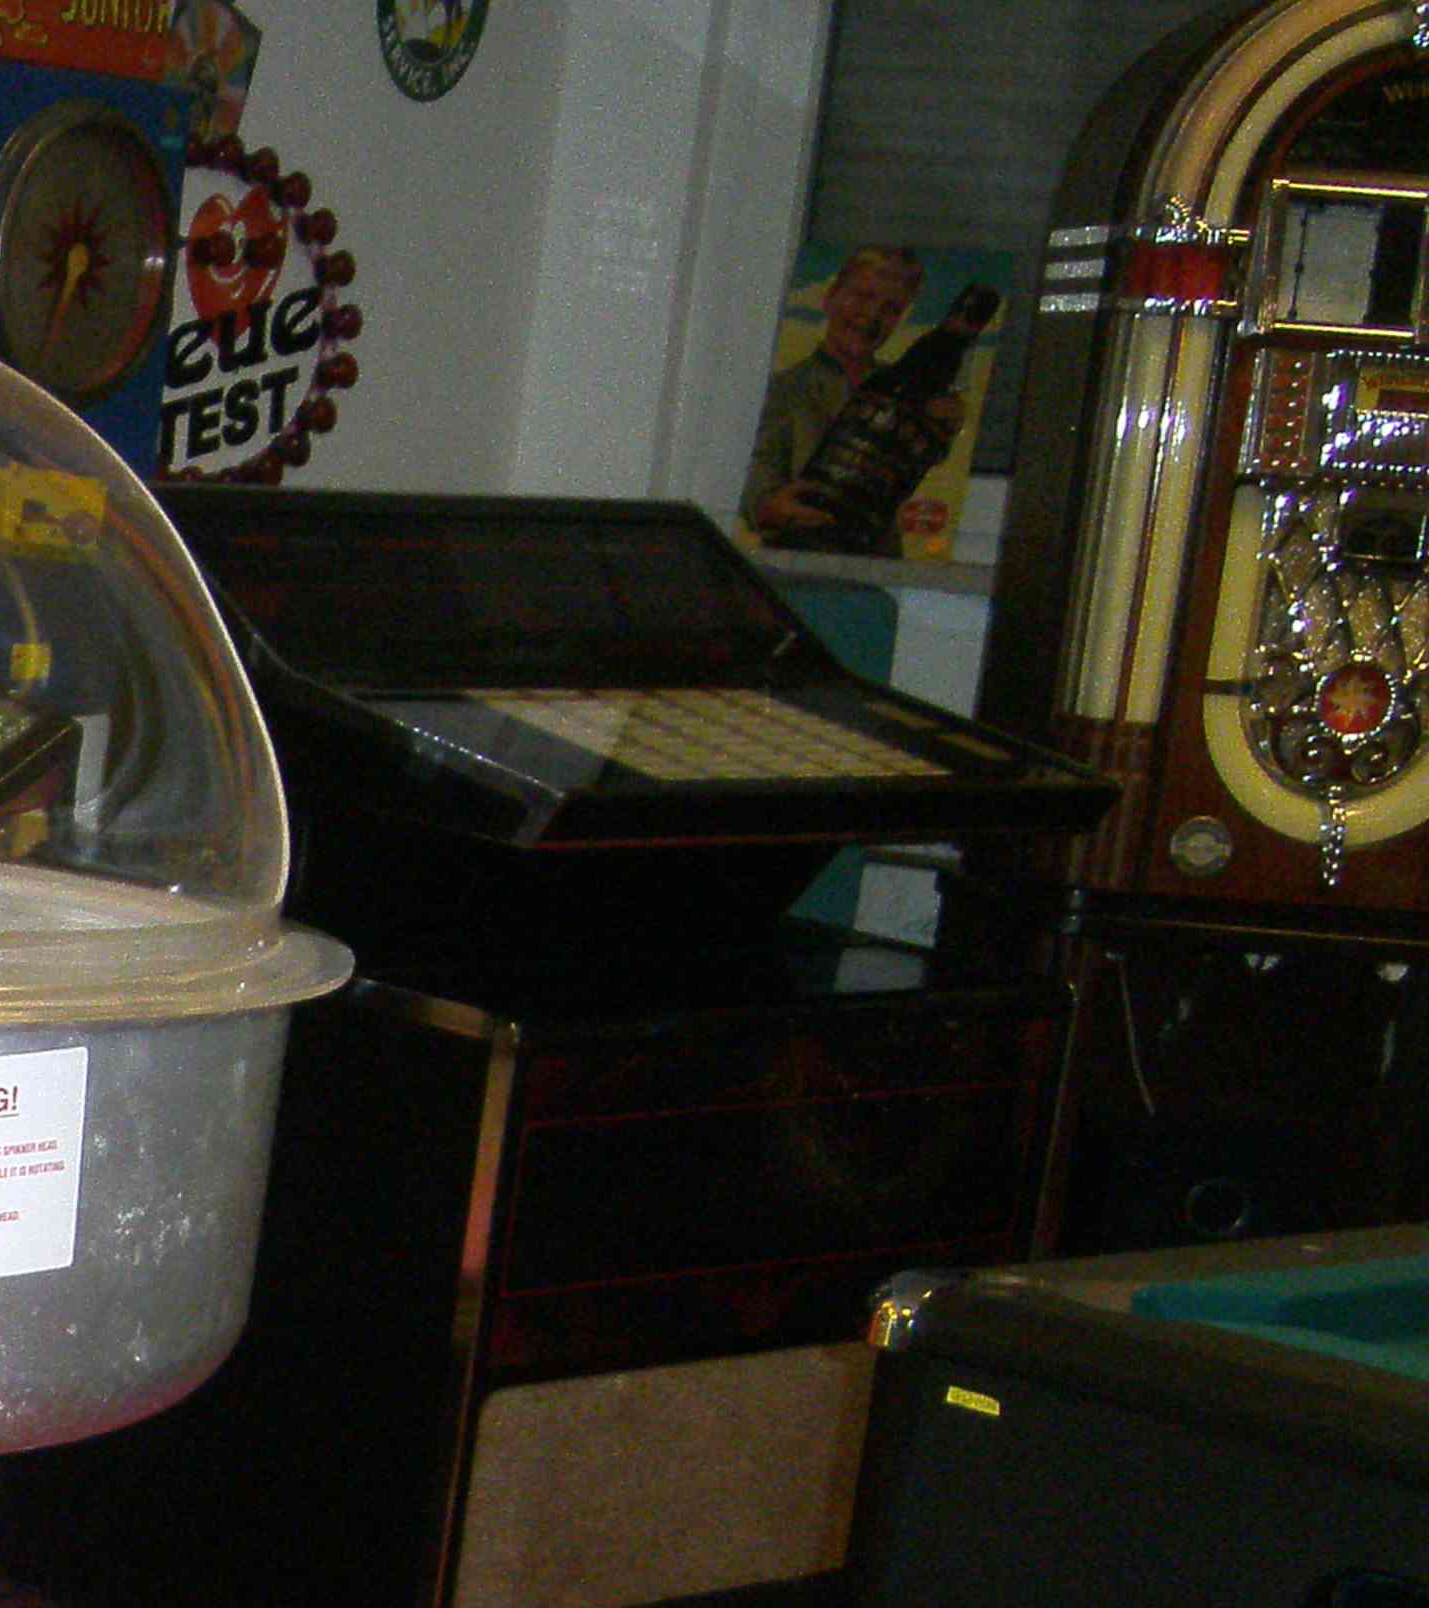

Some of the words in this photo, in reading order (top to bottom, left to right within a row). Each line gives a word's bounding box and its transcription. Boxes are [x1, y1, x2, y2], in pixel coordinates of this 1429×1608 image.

[160, 365, 299, 468] TEST
[3, 1142, 36, 1156] SPINNER
[9, 1166, 18, 1177] IT
